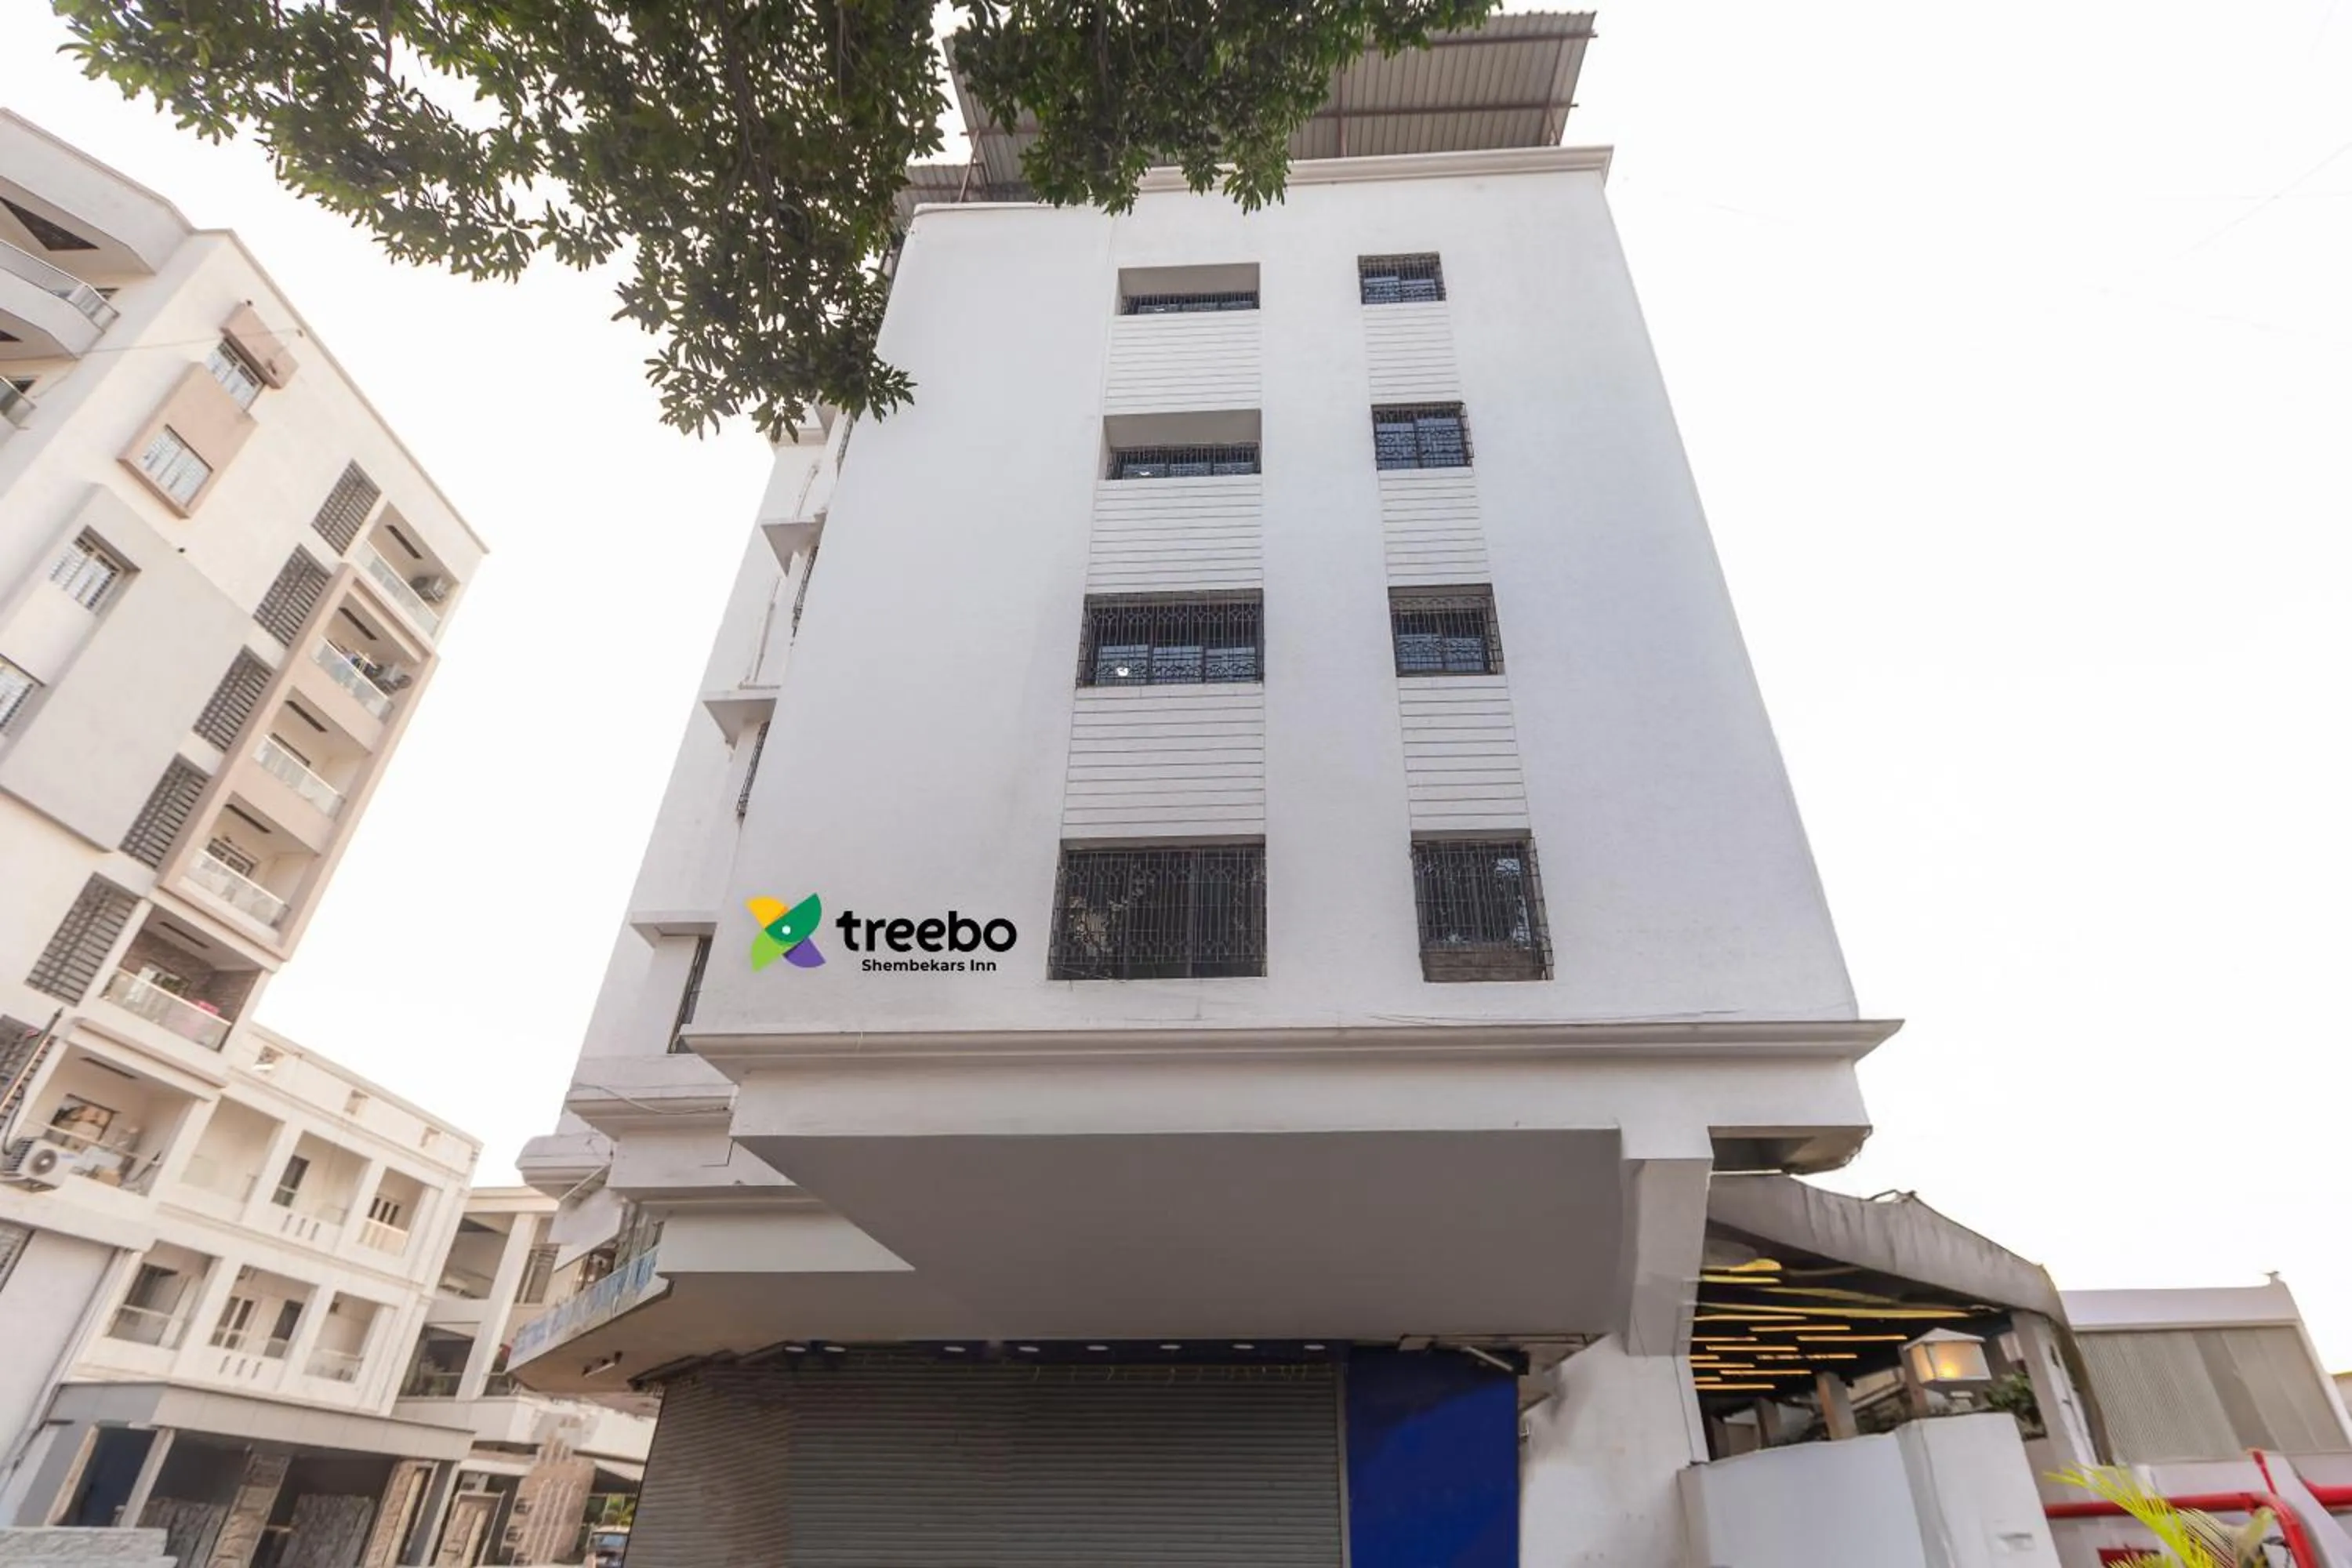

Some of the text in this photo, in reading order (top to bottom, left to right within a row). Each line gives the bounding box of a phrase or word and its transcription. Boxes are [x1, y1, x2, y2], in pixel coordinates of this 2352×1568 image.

[836, 910, 1018, 953] treebo
[862, 958, 997, 972] Shembekars Inn
